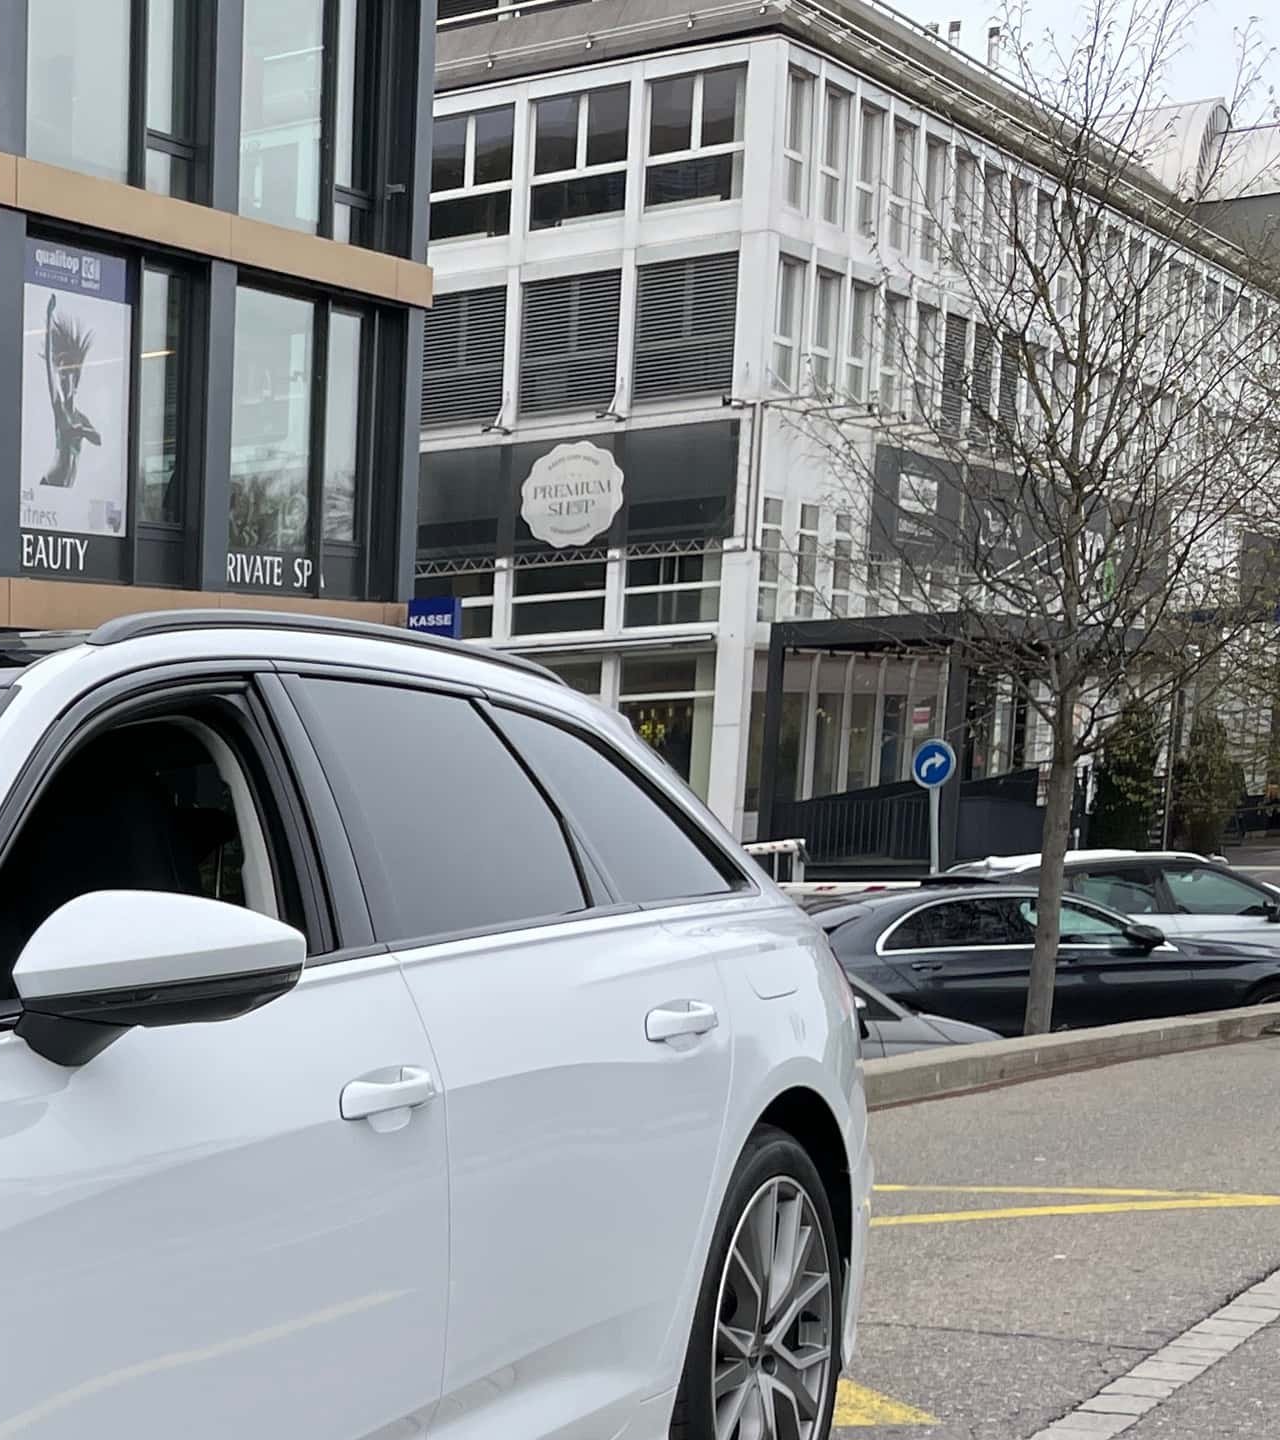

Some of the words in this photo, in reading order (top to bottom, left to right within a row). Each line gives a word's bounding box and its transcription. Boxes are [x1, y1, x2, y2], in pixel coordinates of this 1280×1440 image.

[35, 249, 79, 274] qualitop
[533, 480, 612, 500] PREMIUM
[21, 534, 88, 571] EAUTY
[226, 553, 282, 586] RIVATE
[294, 558, 326, 588] SP
[409, 614, 452, 628] KASSE
